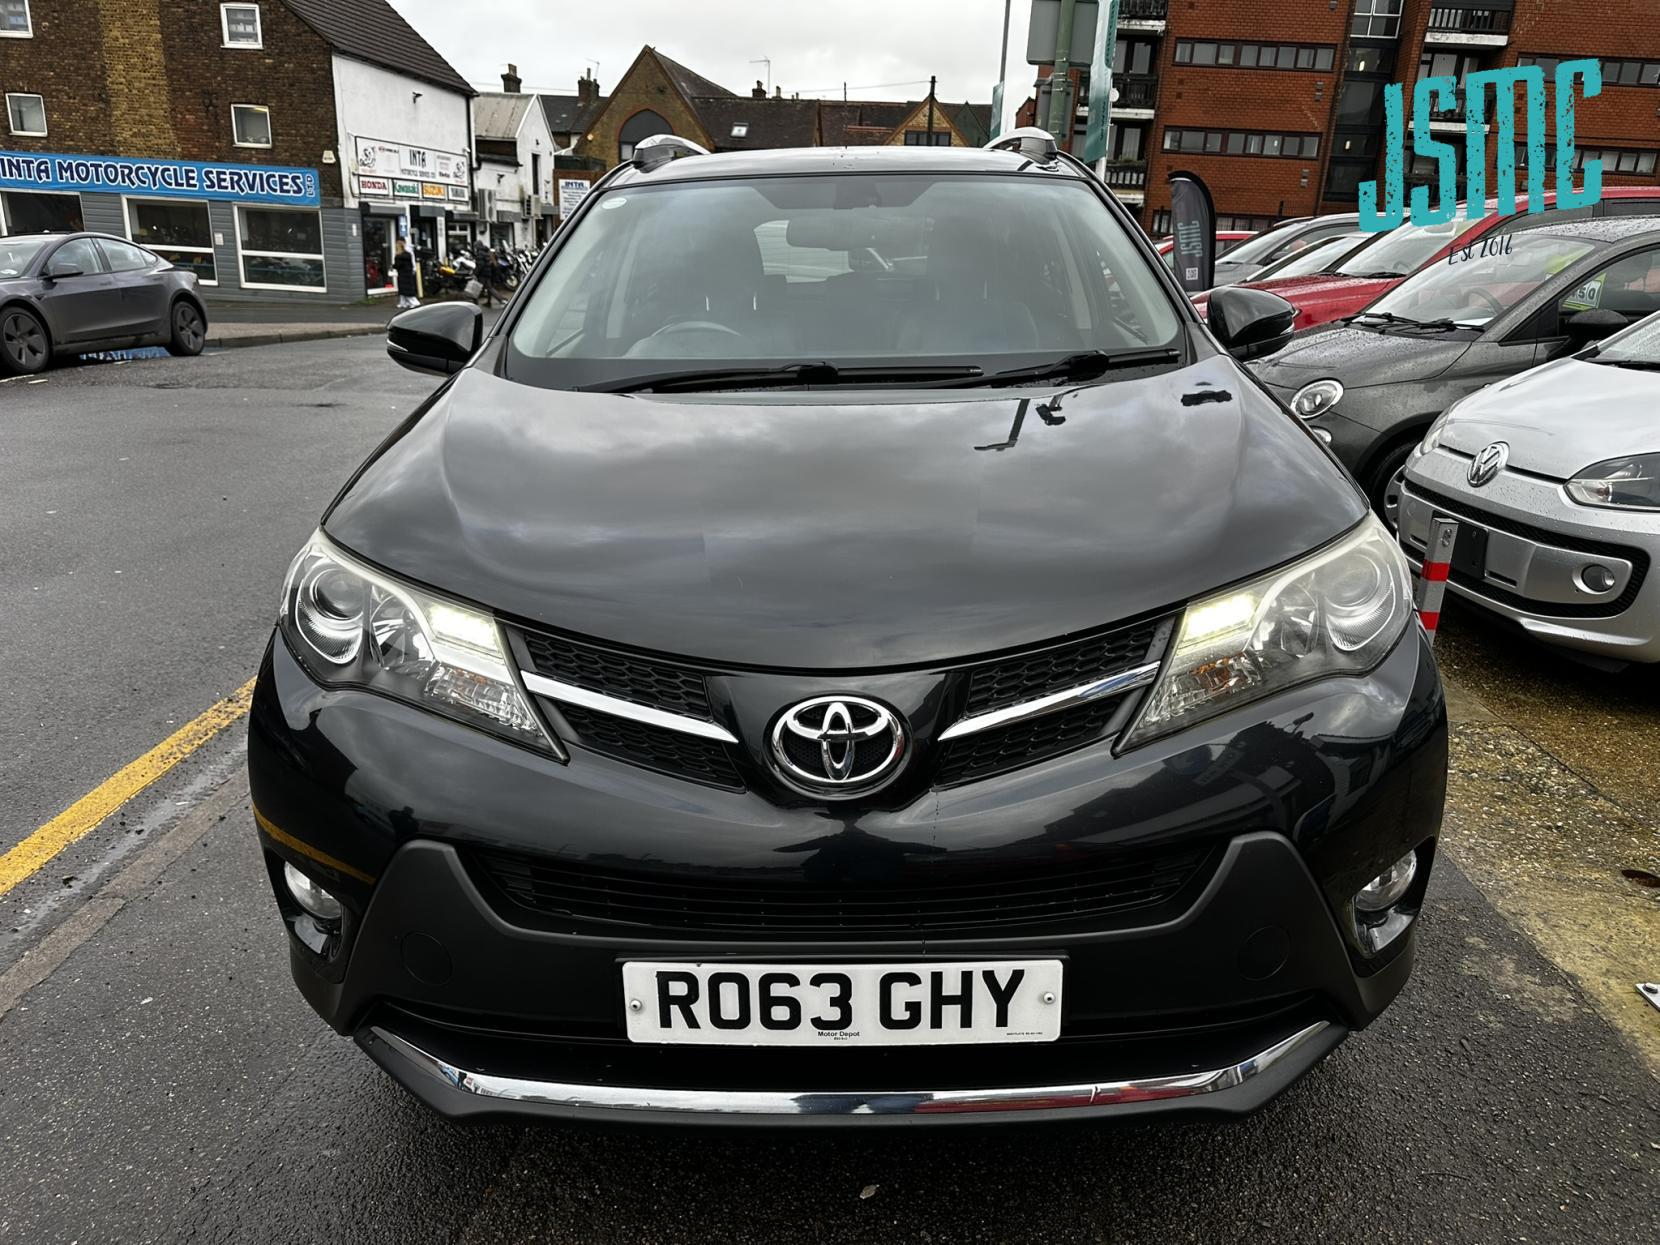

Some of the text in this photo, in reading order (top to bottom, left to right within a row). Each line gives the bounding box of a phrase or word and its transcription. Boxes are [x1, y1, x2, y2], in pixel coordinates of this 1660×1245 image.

[409, 149, 427, 168] INTA
[0, 156, 316, 197] INTA MOTORCYCLE SERVICES LTD
[361, 180, 387, 190] HONDA
[656, 969, 1025, 1031] RO63 GHY
